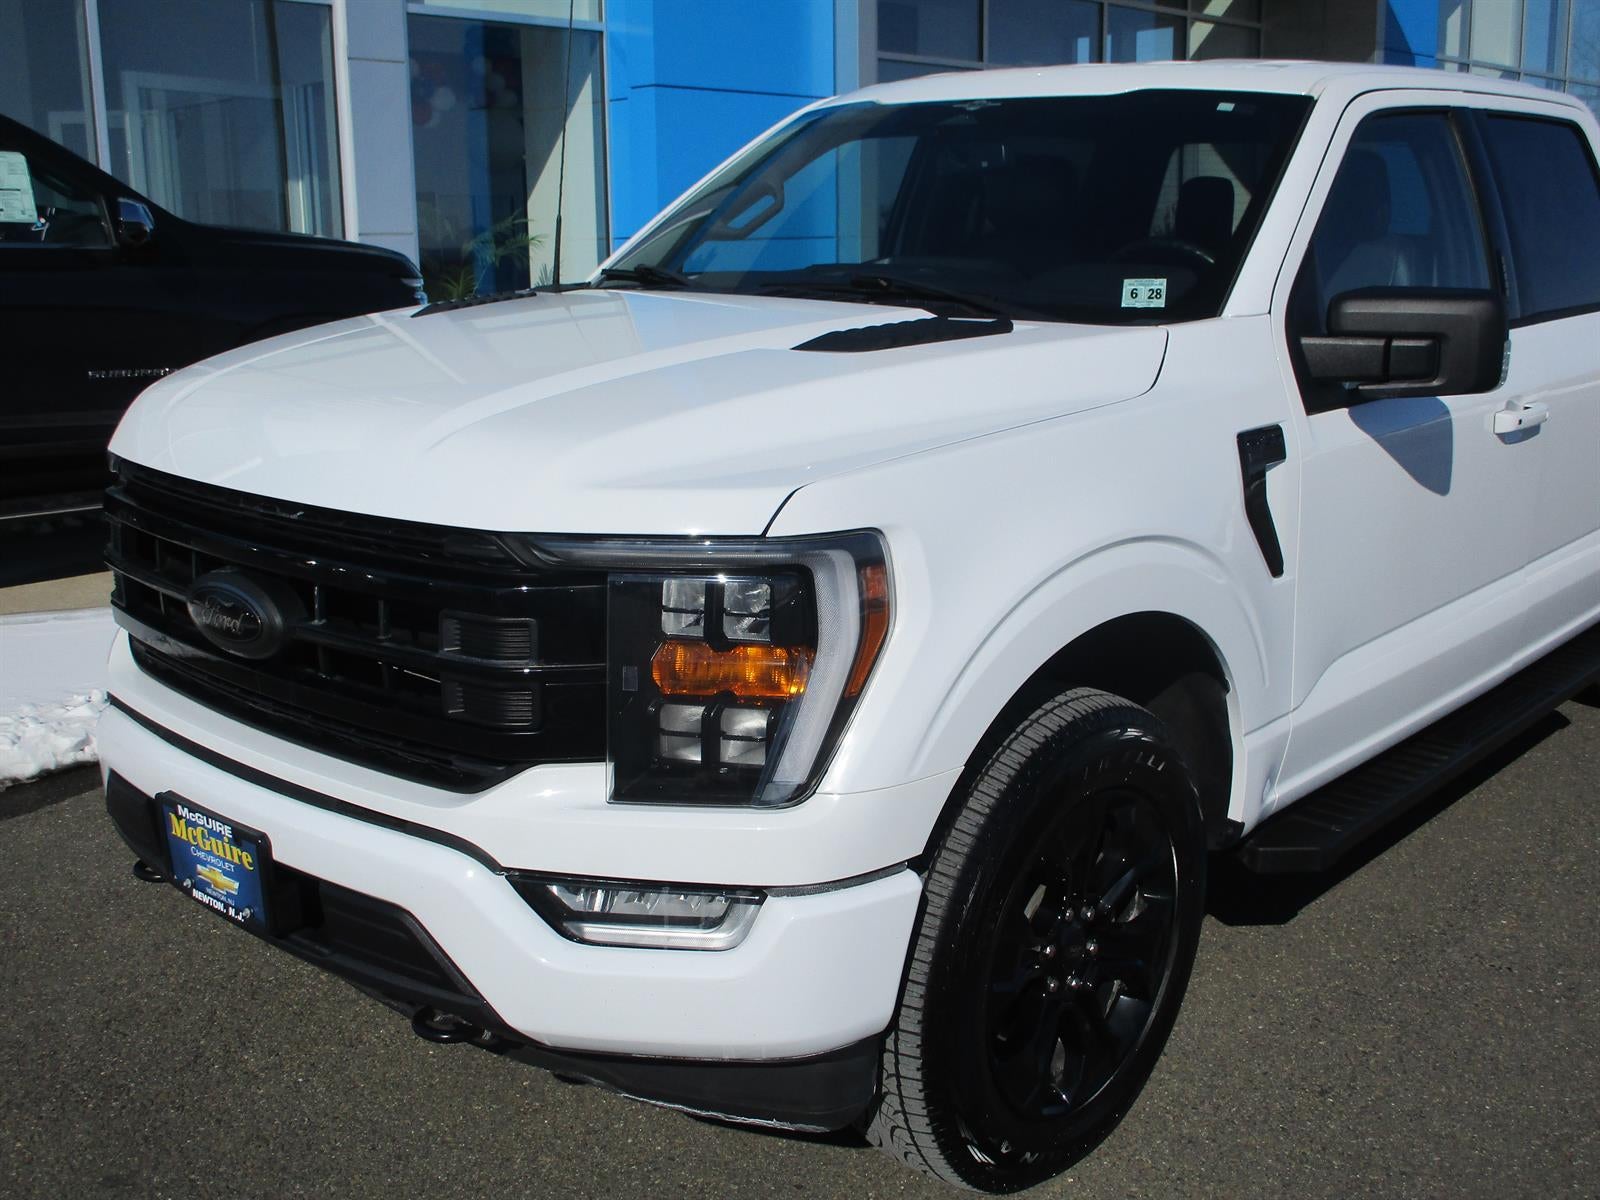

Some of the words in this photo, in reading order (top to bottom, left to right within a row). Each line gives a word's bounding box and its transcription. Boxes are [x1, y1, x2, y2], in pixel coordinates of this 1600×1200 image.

[1130, 288, 1138, 300] 6
[1147, 288, 1162, 300] 28
[200, 596, 244, 634] Ford
[177, 804, 233, 838] McGUIRE
[169, 812, 254, 870] McGuire
[190, 846, 235, 872] CHEVROLET
